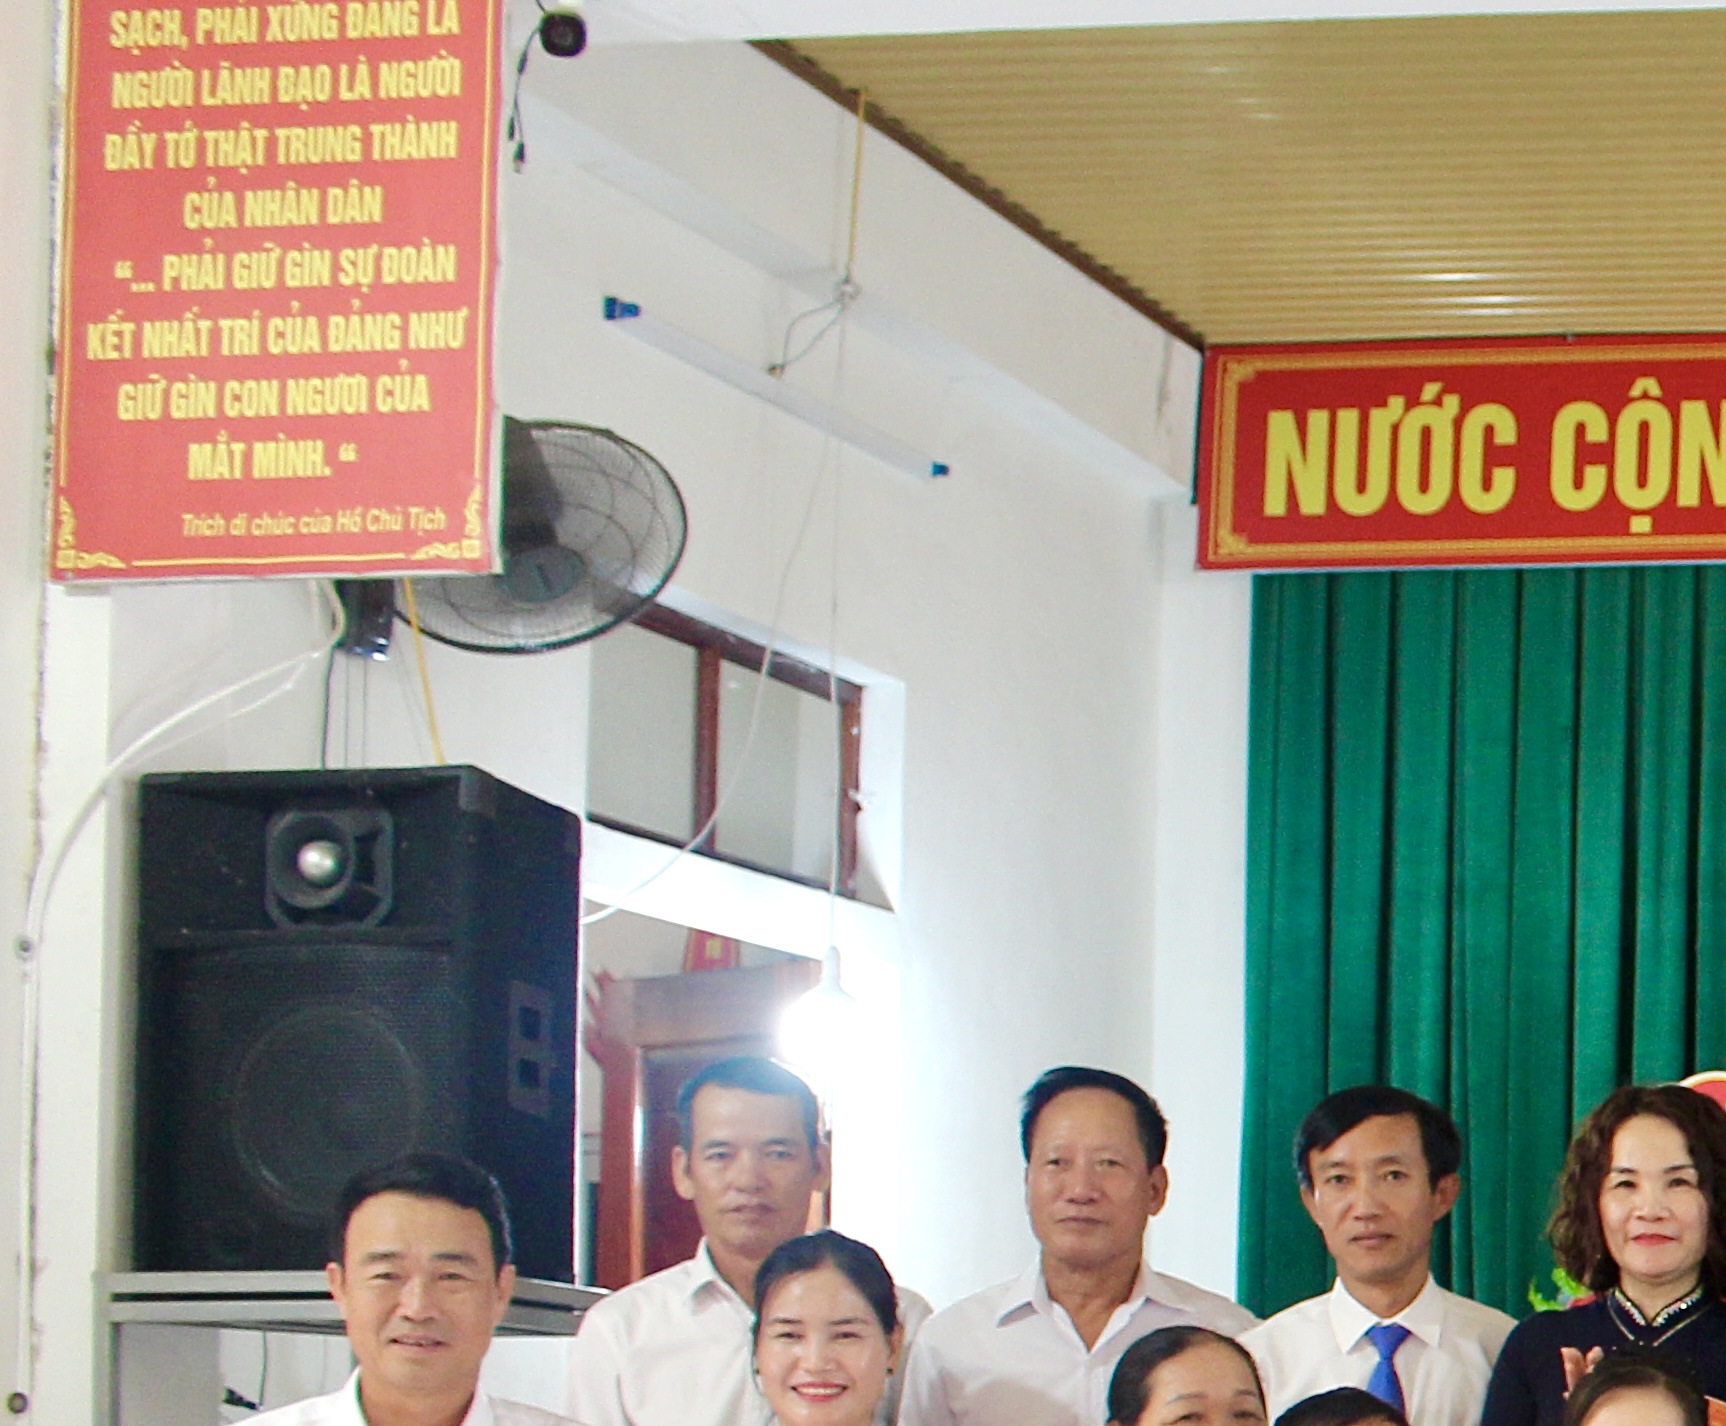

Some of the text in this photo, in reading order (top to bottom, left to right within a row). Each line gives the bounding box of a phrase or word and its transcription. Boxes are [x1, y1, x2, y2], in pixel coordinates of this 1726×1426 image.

[110, 10, 189, 55] SẠCH,
[112, 49, 462, 110] NGƯỜI LÃNH ĐẠO LÀ NGƯỜI
[203, 121, 269, 174] THẬT
[275, 125, 362, 164] TRUNG
[369, 115, 458, 160] THÀNH
[183, 176, 383, 229] CỦA NHÂN DÂN
[162, 238, 226, 291] PHẢI
[232, 242, 283, 289] GIỮ
[284, 242, 332, 288] GÌN
[338, 244, 379, 293] SỰ
[381, 237, 457, 284] ĐOÀN
[218, 310, 261, 356] TRÍ
[267, 300, 322, 354] CỦA
[327, 299, 402, 353] ĐẢNG
[408, 307, 469, 349] NHƯ
[117, 373, 168, 420] GIỮ
[169, 374, 217, 419] GÌN
[224, 379, 280, 417] CON
[375, 359, 431, 413] CỦA
[252, 433, 332, 479] MÌNH.
[1264, 382, 1517, 516] NƯỚC
